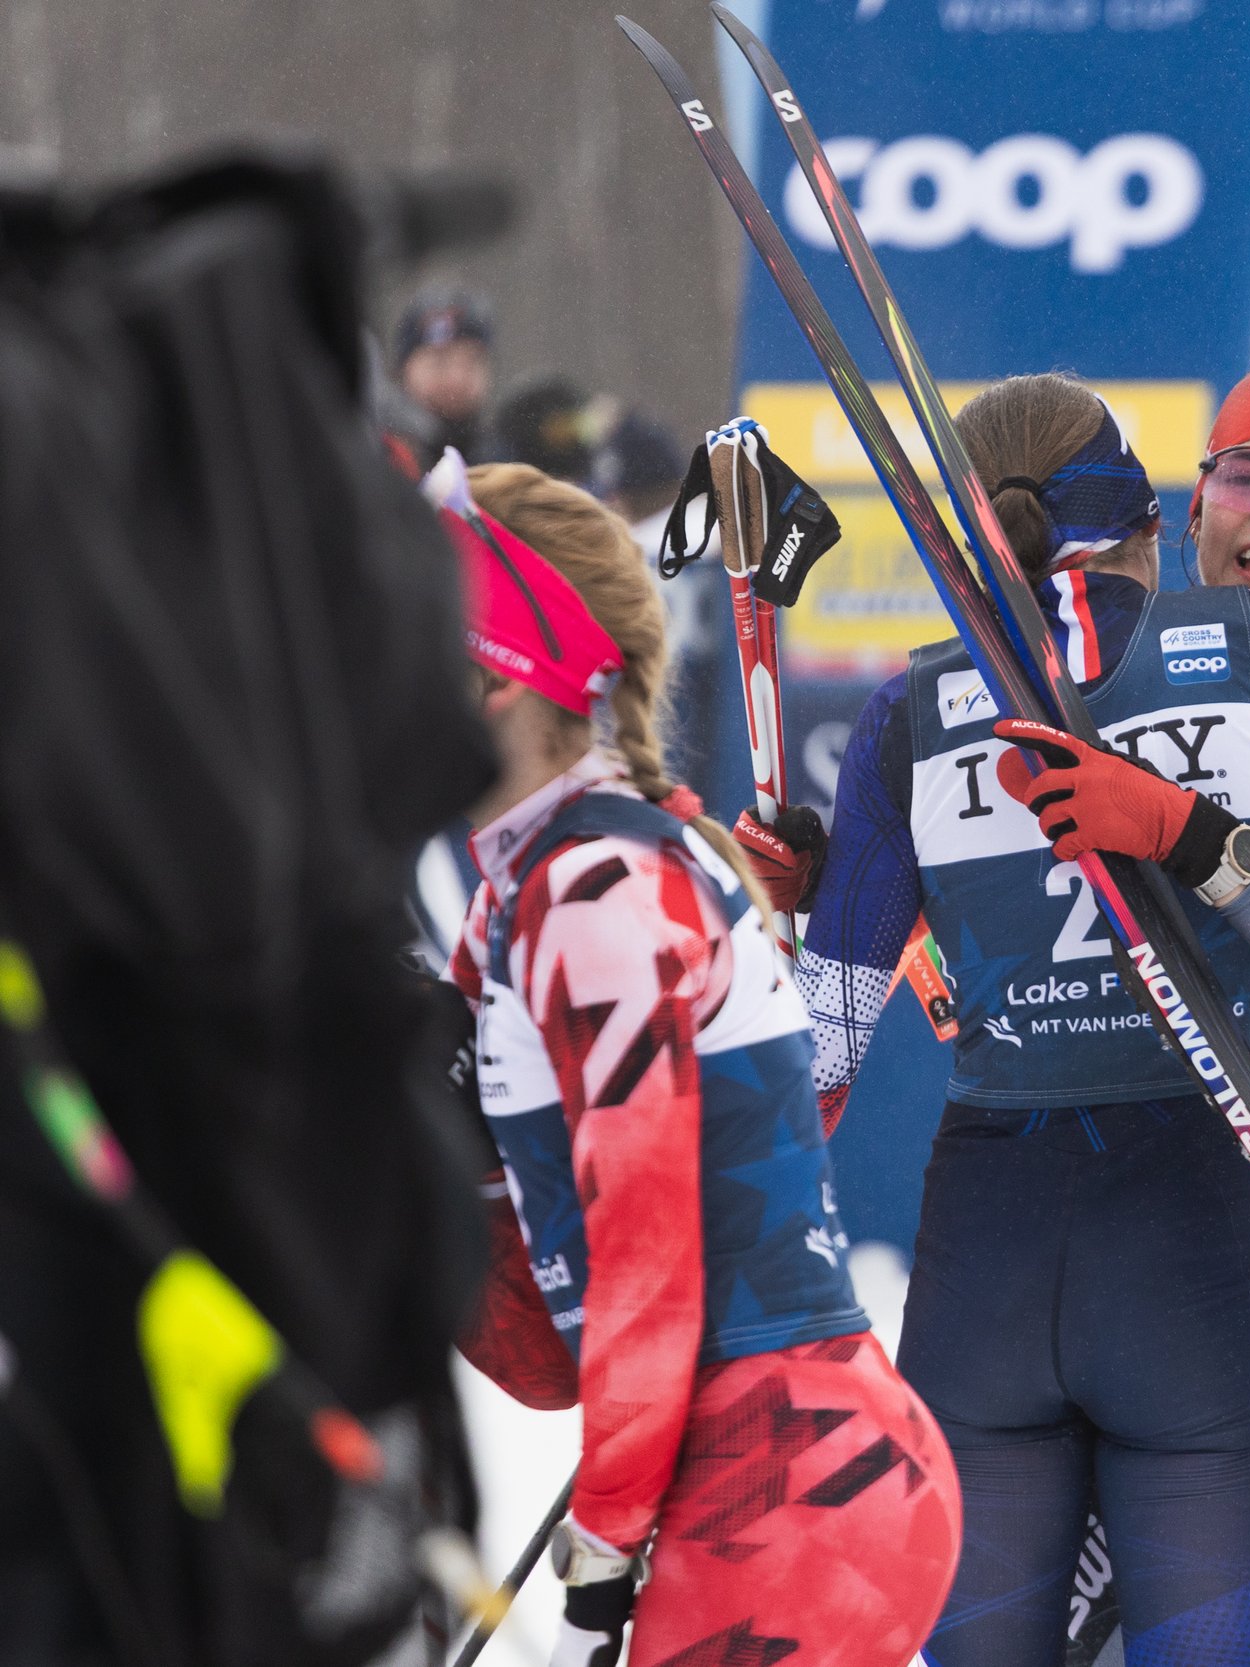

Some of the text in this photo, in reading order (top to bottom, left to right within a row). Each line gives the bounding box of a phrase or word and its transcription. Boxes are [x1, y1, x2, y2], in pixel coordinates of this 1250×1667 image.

[784, 134, 1203, 274] coop
[771, 523, 805, 582] SWIX
[1182, 629, 1211, 637] CROSS
[1183, 634, 1222, 642] COUNTRY
[1167, 656, 1227, 674] coop
[948, 692, 990, 712] FIS
[1011, 721, 1056, 735] AUCLAIR
[955, 752, 994, 820] I
[736, 820, 775, 847] AUCLAIR
[1008, 975, 1089, 1006] Lake
[1031, 1019, 1060, 1035] MT
[1066, 1017, 1107, 1034] VAN
